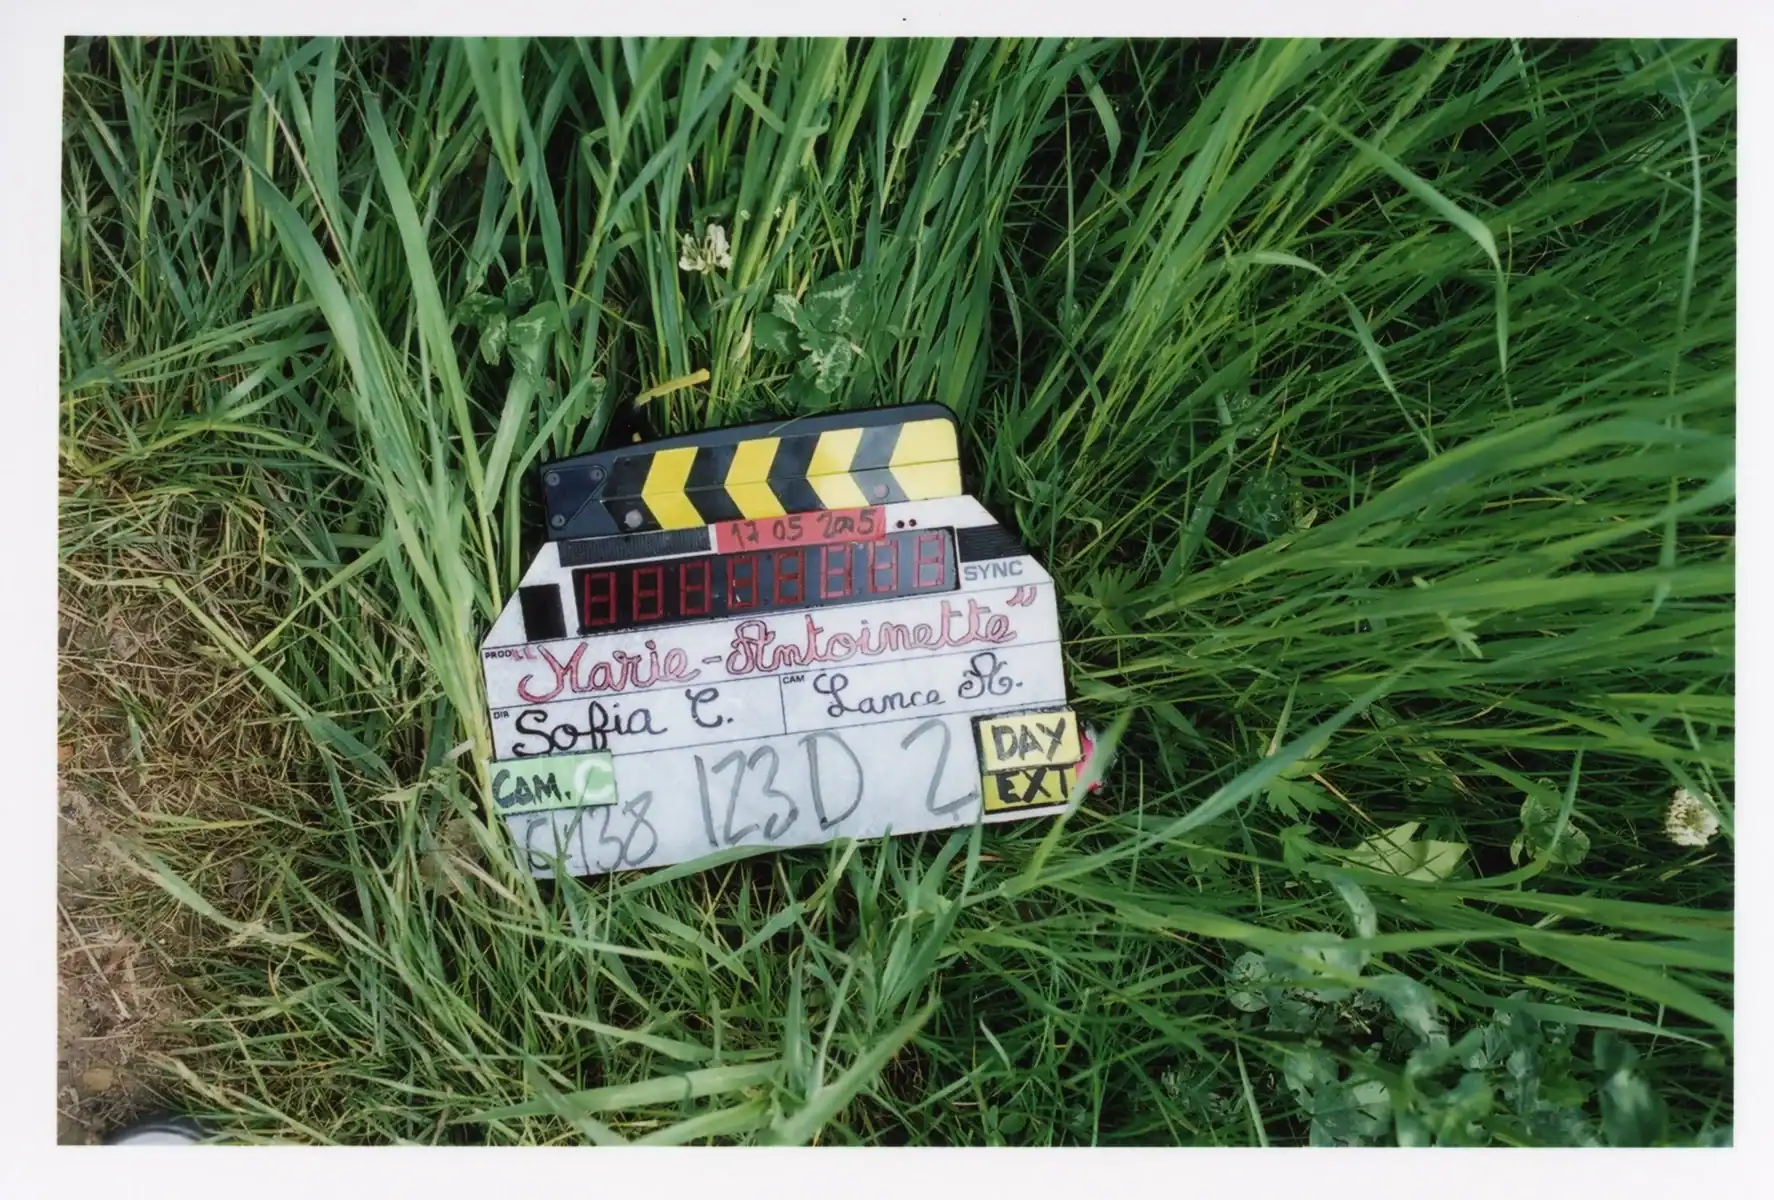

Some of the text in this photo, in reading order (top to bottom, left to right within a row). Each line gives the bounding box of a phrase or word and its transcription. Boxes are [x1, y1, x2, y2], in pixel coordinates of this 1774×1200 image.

[773, 516, 804, 541] 05
[963, 560, 1023, 581] SYNC
[782, 674, 806, 685] CAM
[813, 671, 946, 718] Lance
[493, 710, 510, 720] DIR
[511, 700, 668, 757] Sofia
[991, 717, 1067, 762] DAY
[491, 758, 613, 809] CAM. C
[900, 718, 980, 816] 2
[995, 763, 1074, 804] EXT
